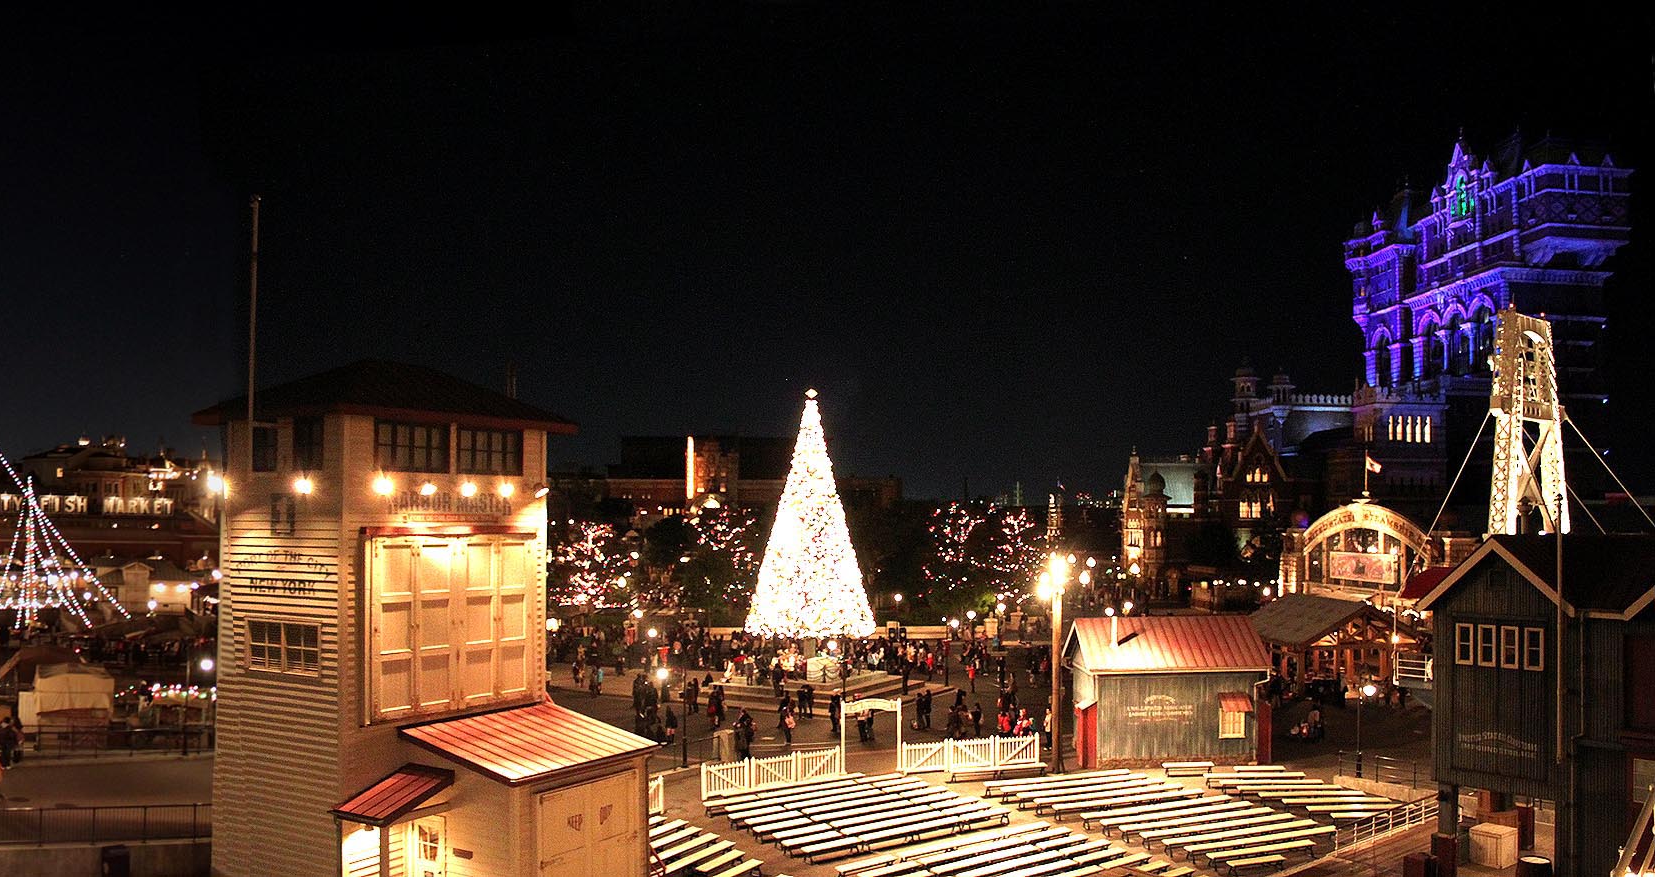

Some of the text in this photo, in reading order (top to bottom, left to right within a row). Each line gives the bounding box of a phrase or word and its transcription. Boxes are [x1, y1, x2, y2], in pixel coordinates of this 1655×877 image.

[39, 495, 88, 513] FISH
[102, 496, 174, 515] MARKET
[456, 491, 512, 516] MASTER
[266, 549, 280, 561] OF
[283, 549, 303, 563] THE
[249, 577, 317, 597] NEW YORK
